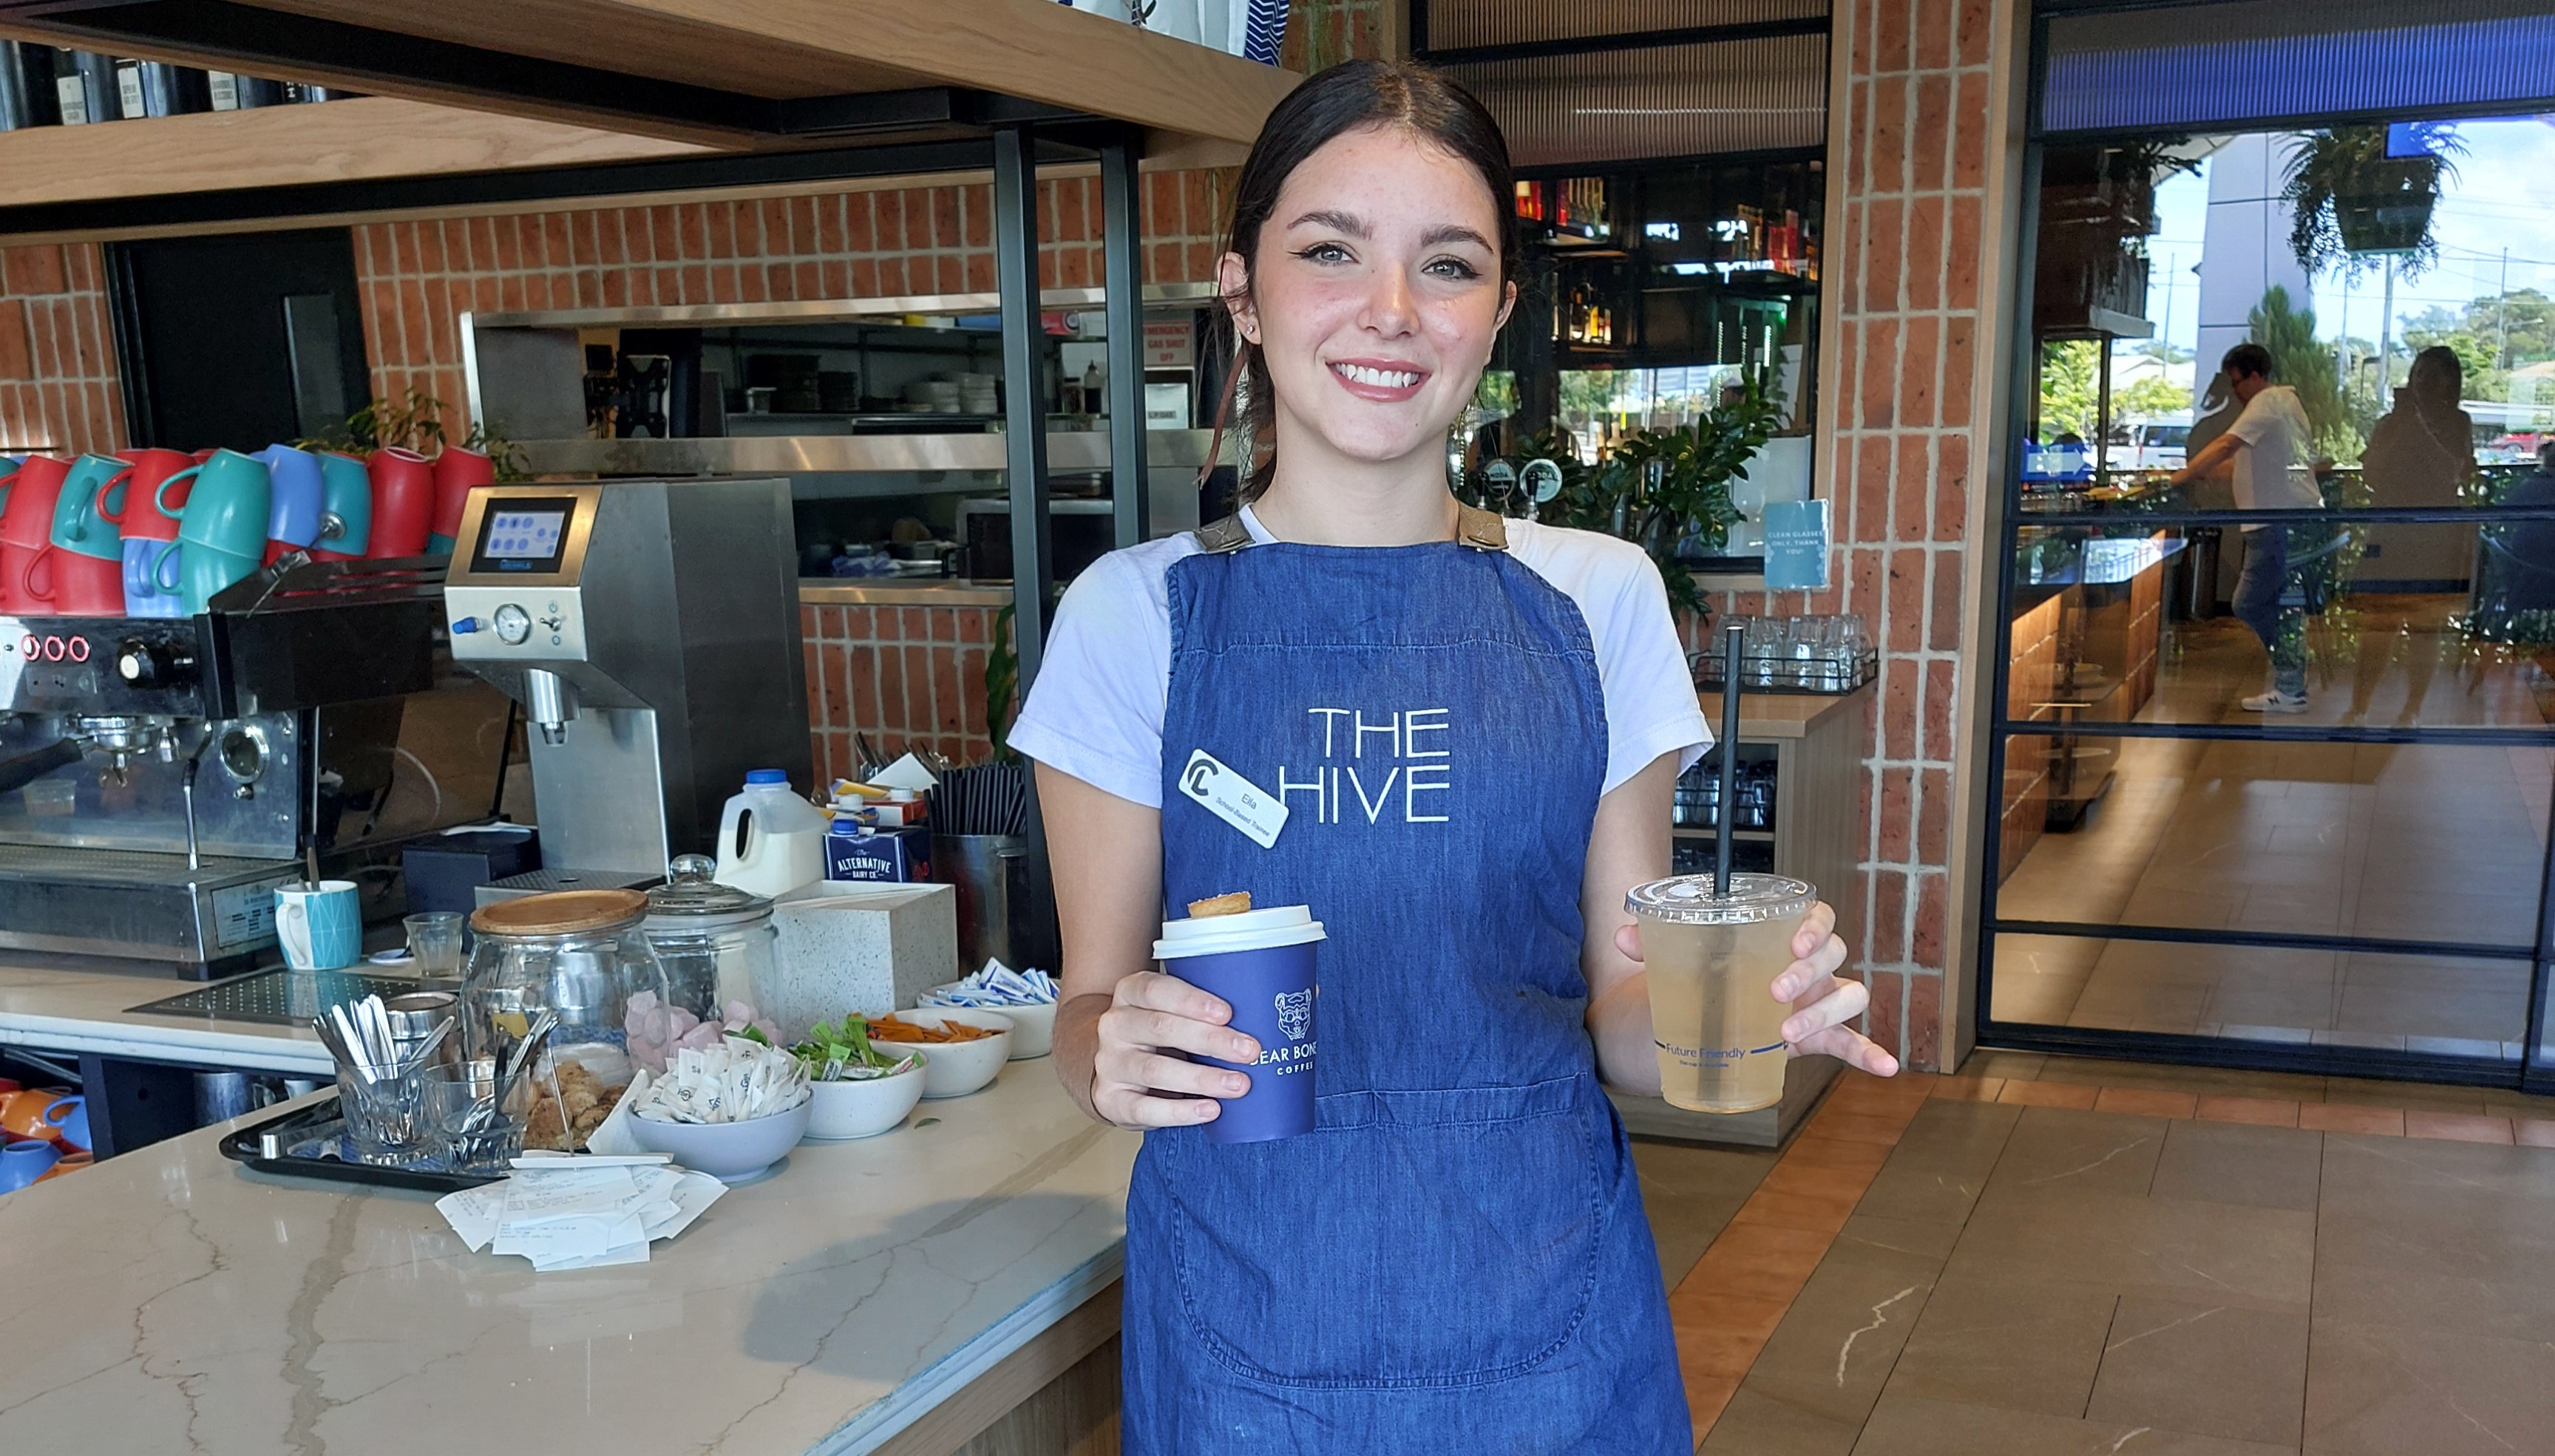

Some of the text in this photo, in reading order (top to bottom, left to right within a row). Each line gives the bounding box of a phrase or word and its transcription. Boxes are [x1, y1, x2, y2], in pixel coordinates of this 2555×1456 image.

[1147, 339, 1184, 349] GAS SHUT
[1159, 353, 1174, 362] OFF
[1308, 707, 1450, 759] THE
[1241, 792, 1257, 810] Ella
[1279, 765, 1450, 825] HIVE
[837, 857, 892, 874] ALTERNATIVE
[852, 871, 868, 879] DAIRY
[1249, 1047, 1290, 1066] EAR
[1666, 1043, 1746, 1060] Future Friendly
